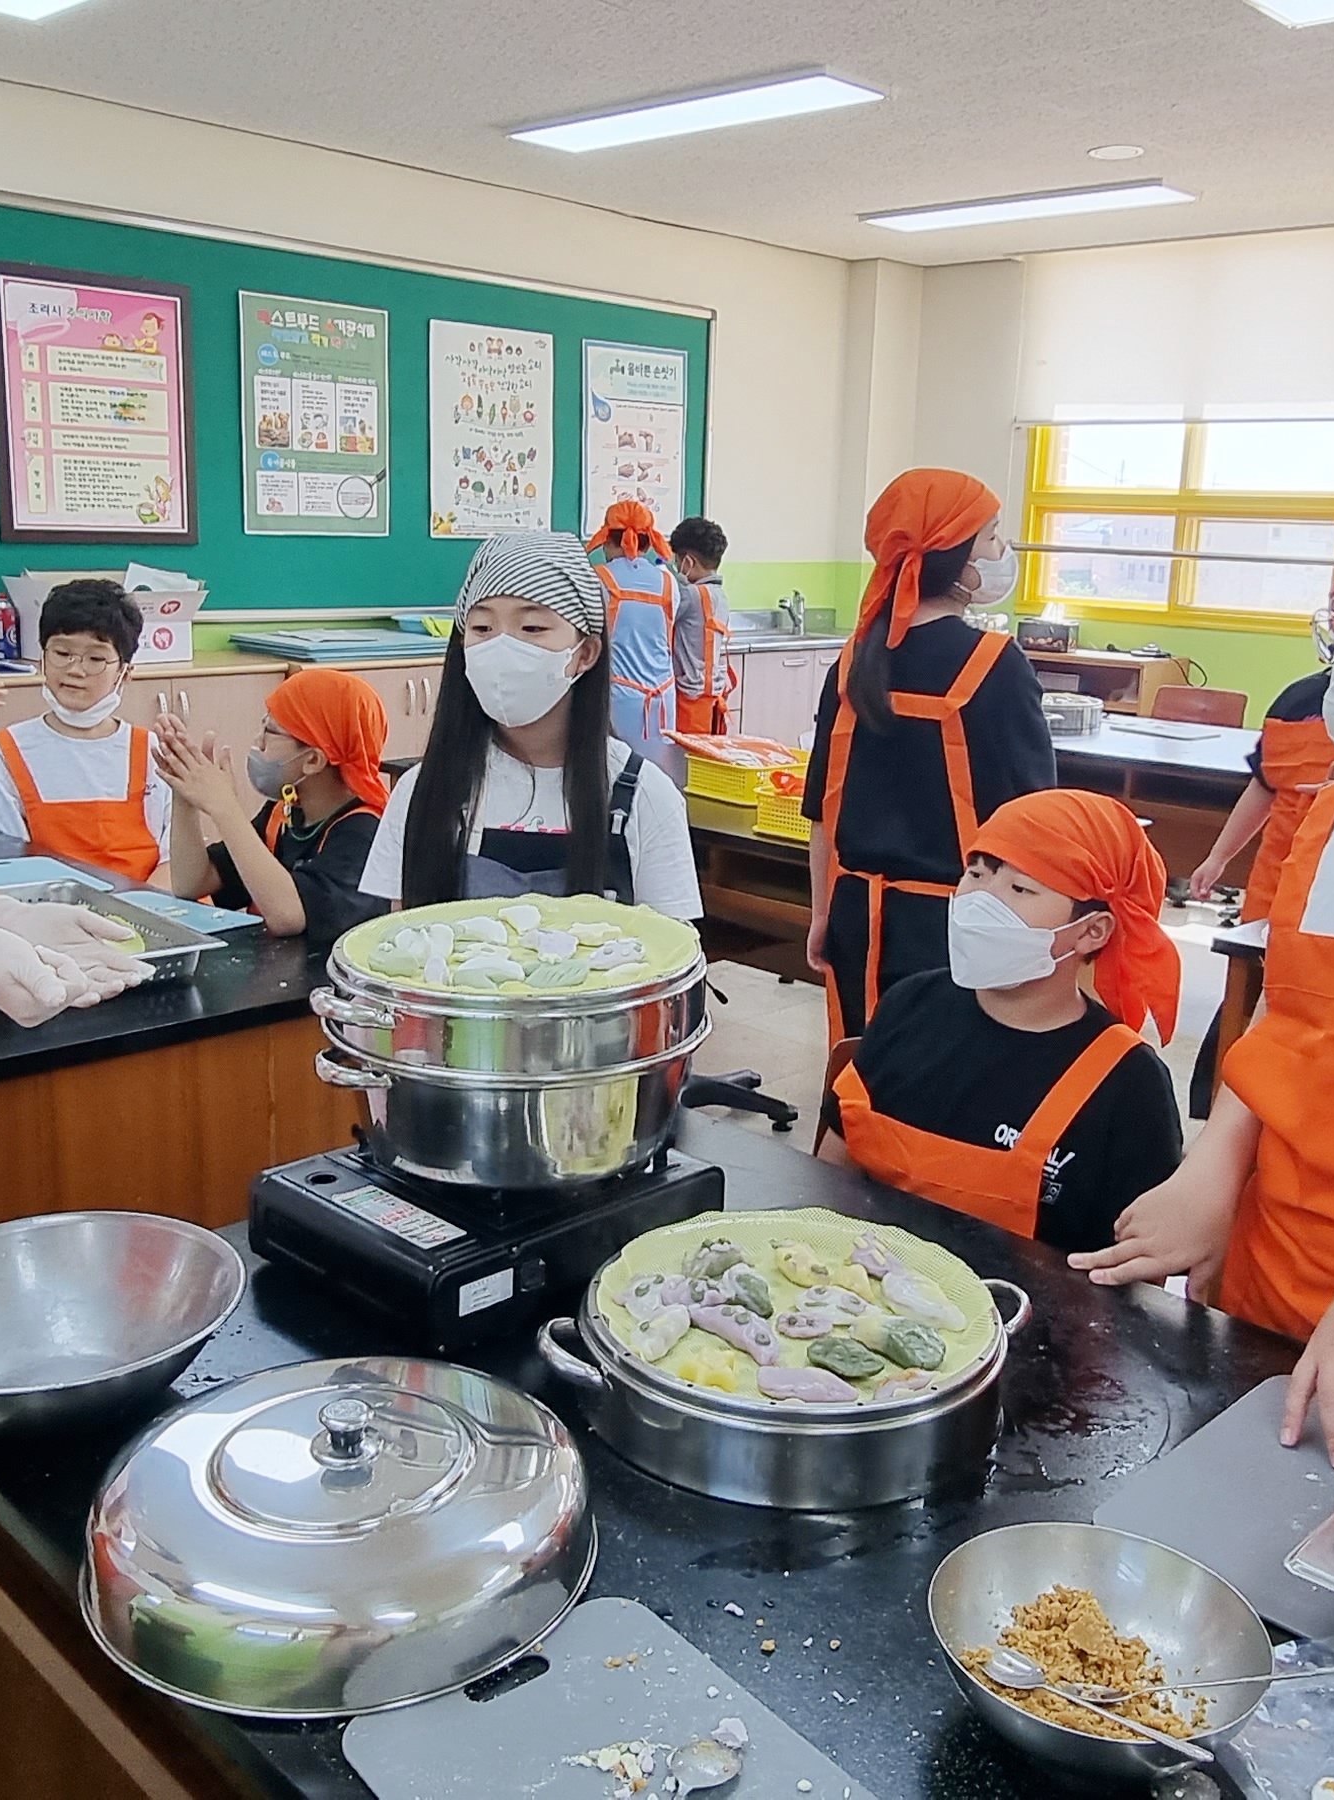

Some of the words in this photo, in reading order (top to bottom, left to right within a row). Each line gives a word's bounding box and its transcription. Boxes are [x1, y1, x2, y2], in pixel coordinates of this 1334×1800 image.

[28, 302, 63, 317] 조리시
[627, 362, 651, 378] 올바른
[653, 365, 677, 381] 손씻기
